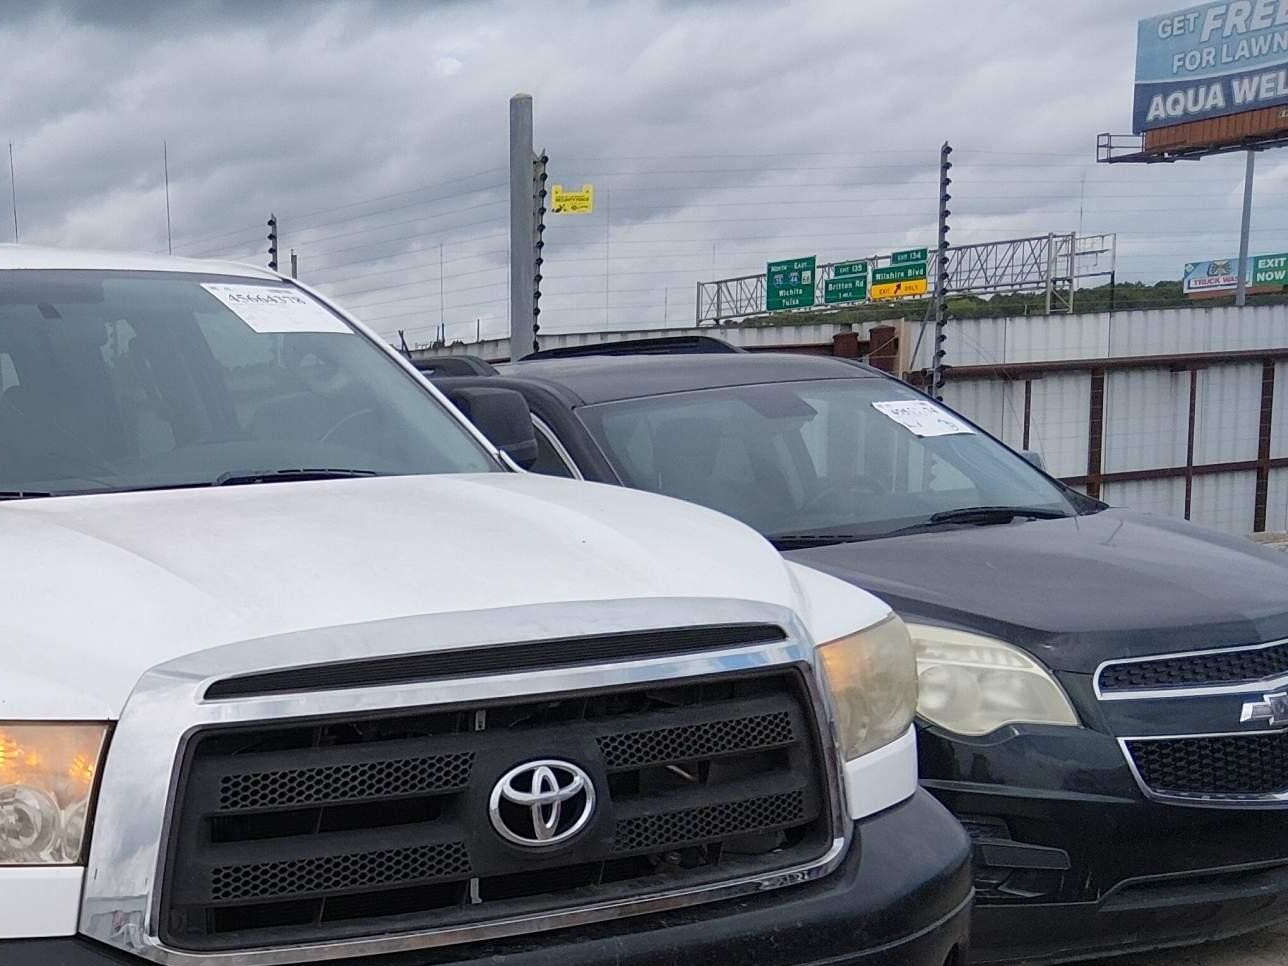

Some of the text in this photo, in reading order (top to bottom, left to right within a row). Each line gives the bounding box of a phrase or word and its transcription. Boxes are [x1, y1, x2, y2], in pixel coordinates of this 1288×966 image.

[1158, 13, 1200, 39] GET
[1172, 31, 1288, 74] FOR LAWN
[1146, 70, 1288, 121] AQUA WEL
[1258, 257, 1287, 269] EXIT
[875, 268, 924, 280] Wilshire Blvd
[1256, 270, 1286, 282] NOW
[828, 279, 864, 291] Britton Rd
[1194, 277, 1220, 286] TRUCK
[778, 288, 803, 297] Wichita
[782, 298, 800, 307] Tulsa
